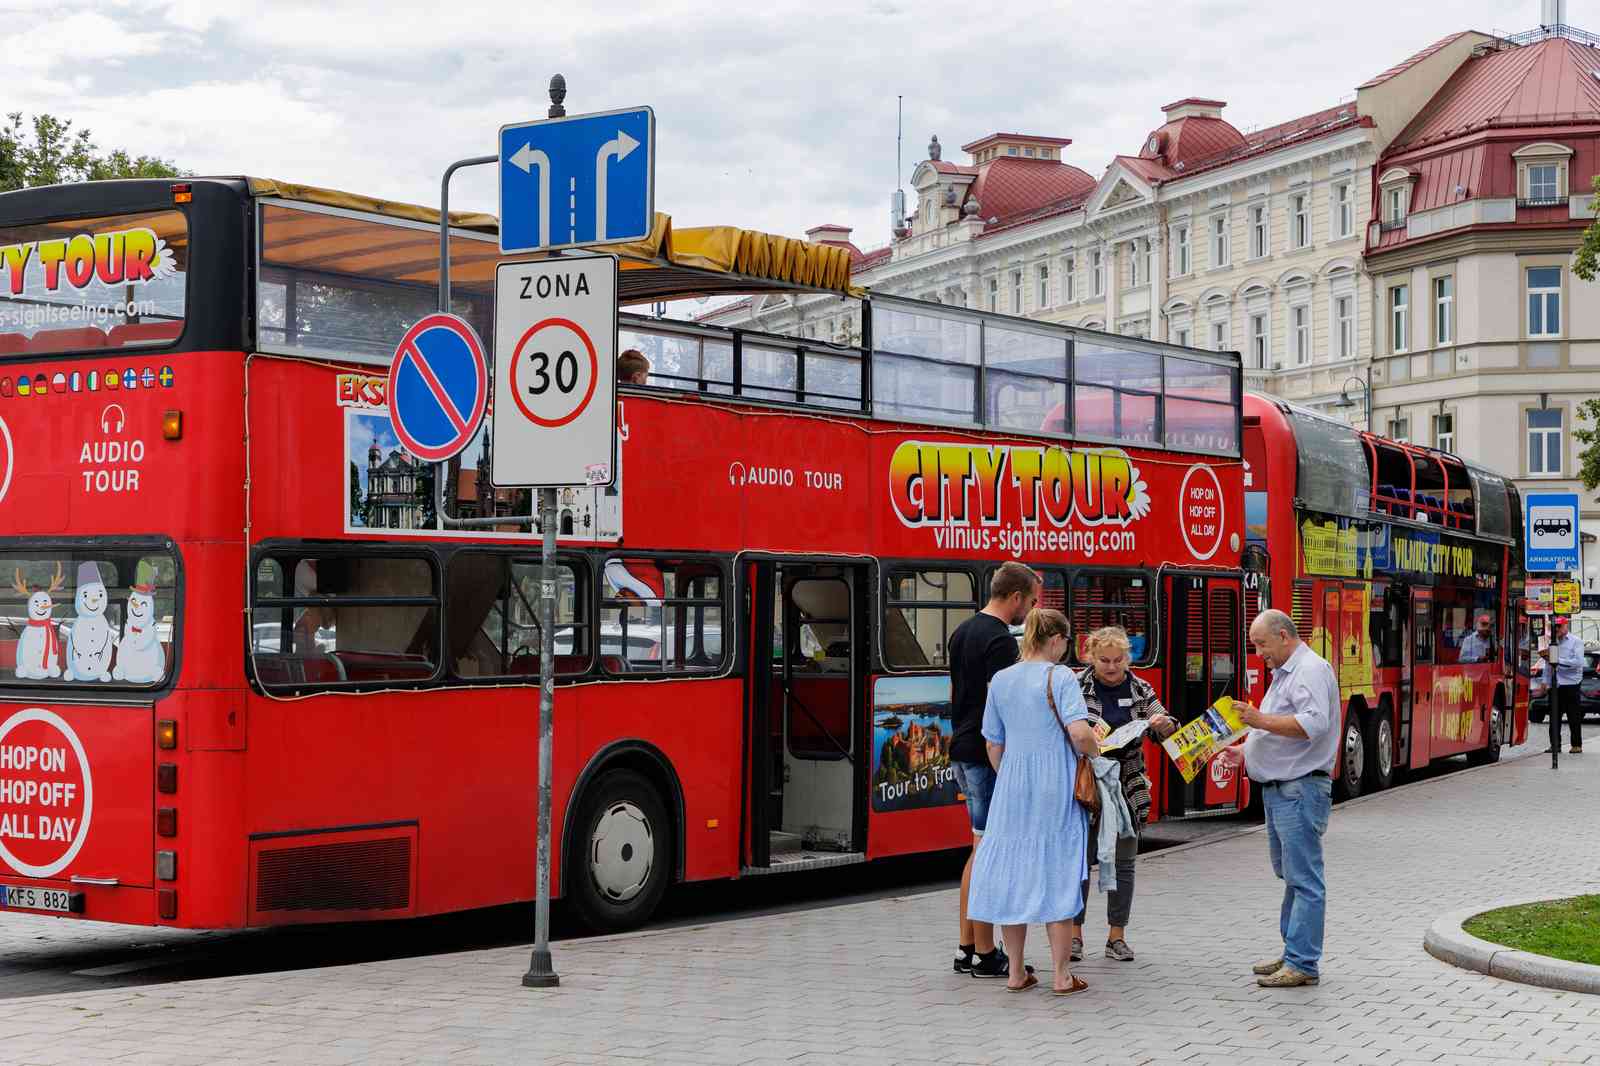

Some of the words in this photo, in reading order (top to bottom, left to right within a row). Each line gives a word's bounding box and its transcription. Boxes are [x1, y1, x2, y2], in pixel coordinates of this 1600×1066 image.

[38, 228, 157, 291] TOUR
[519, 272, 591, 299] ZONA
[528, 350, 578, 395] 30
[79, 440, 145, 463] AUDIO
[82, 469, 139, 492] TOUR
[748, 466, 794, 486] AUDIO
[804, 471, 842, 490] TOUR
[889, 440, 1009, 528] CITY
[1011, 446, 1132, 528] TOUR
[1190, 488, 1203, 500] HOP
[1205, 489, 1214, 500] ON
[1189, 506, 1202, 518] HOP
[1204, 507, 1216, 518] OFF
[933, 521, 1136, 558] vilnius-sightseeing.com
[1191, 524, 1203, 536] ALL
[1204, 525, 1216, 536] DAY
[1394, 537, 1429, 575] VILNIUS
[1431, 543, 1450, 576] CITY
[1451, 545, 1473, 577] TOUR
[0, 745, 37, 770] HOP
[39, 747, 66, 772] ON
[0, 779, 37, 804] HOP
[39, 783, 76, 807] OFF
[879, 781, 910, 802] Tour
[914, 772, 928, 791] to
[0, 813, 35, 839] ALL
[39, 816, 76, 842] DAY
[8, 887, 35, 906] KFS
[43, 891, 67, 909] 882
